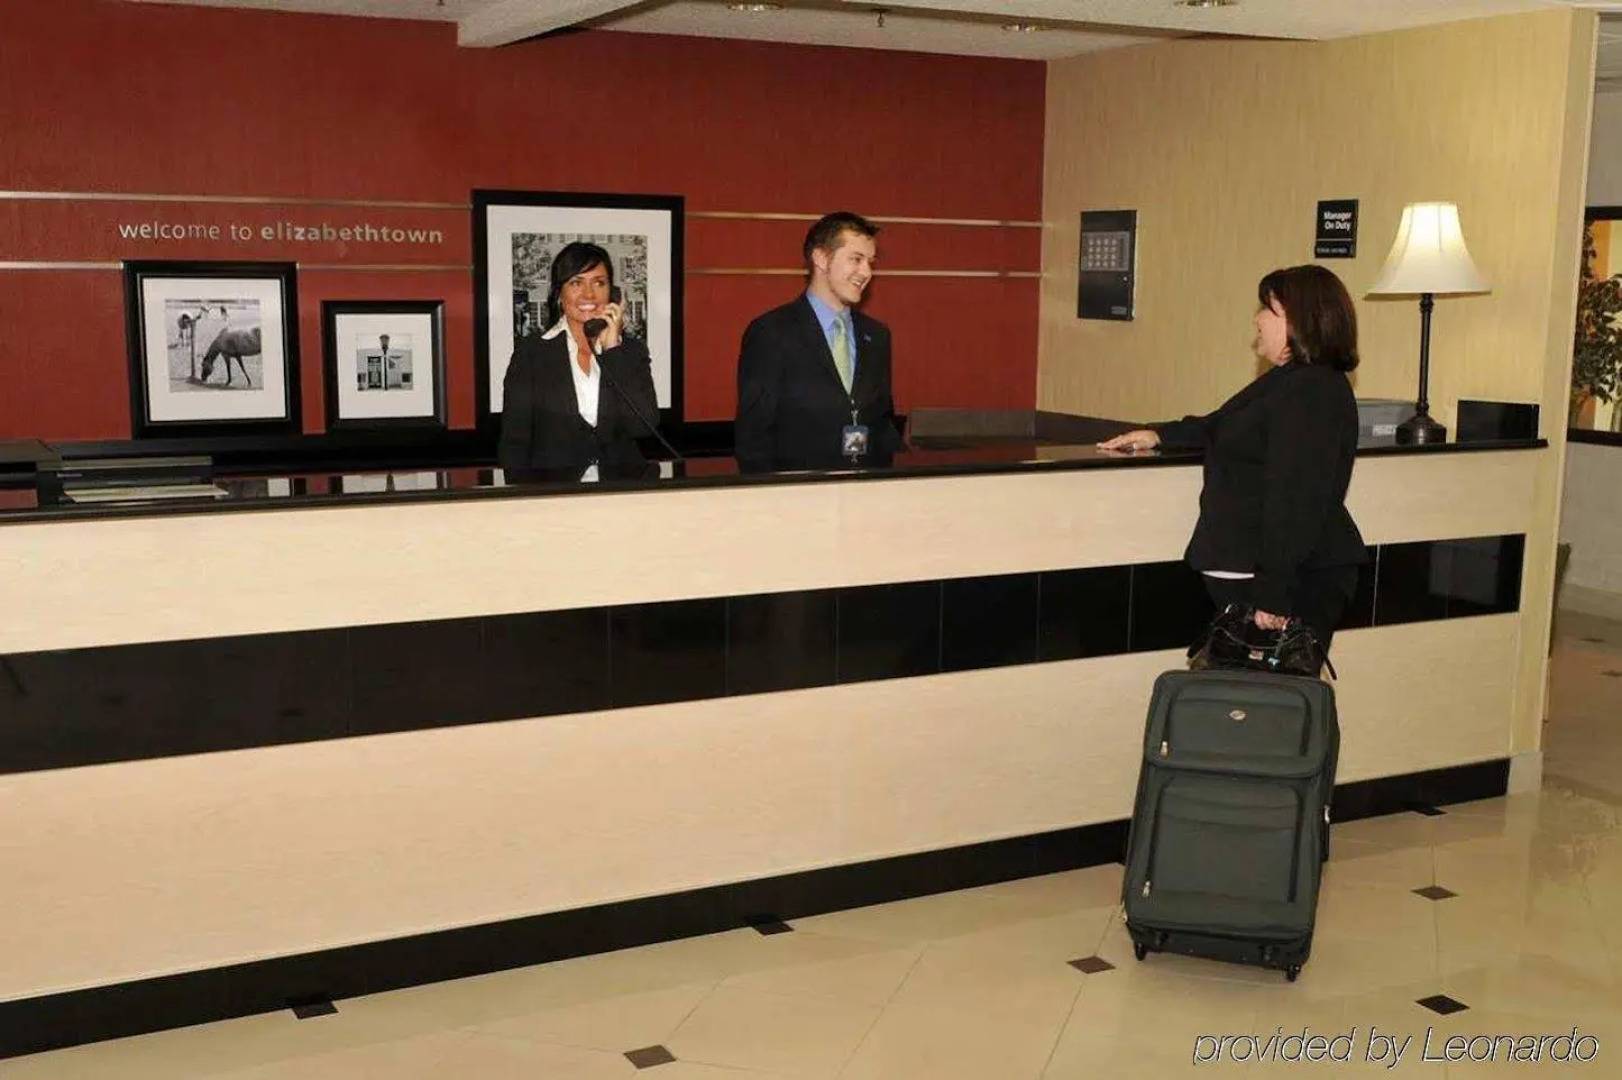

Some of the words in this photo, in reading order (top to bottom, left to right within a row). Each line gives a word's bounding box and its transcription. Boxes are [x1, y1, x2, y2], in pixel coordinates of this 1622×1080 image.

[1323, 211, 1352, 221] Manager
[118, 220, 221, 239] welcome
[230, 224, 253, 240] to
[260, 221, 443, 244] elizabethtown
[1324, 220, 1335, 230] On
[1335, 220, 1351, 232] Duty
